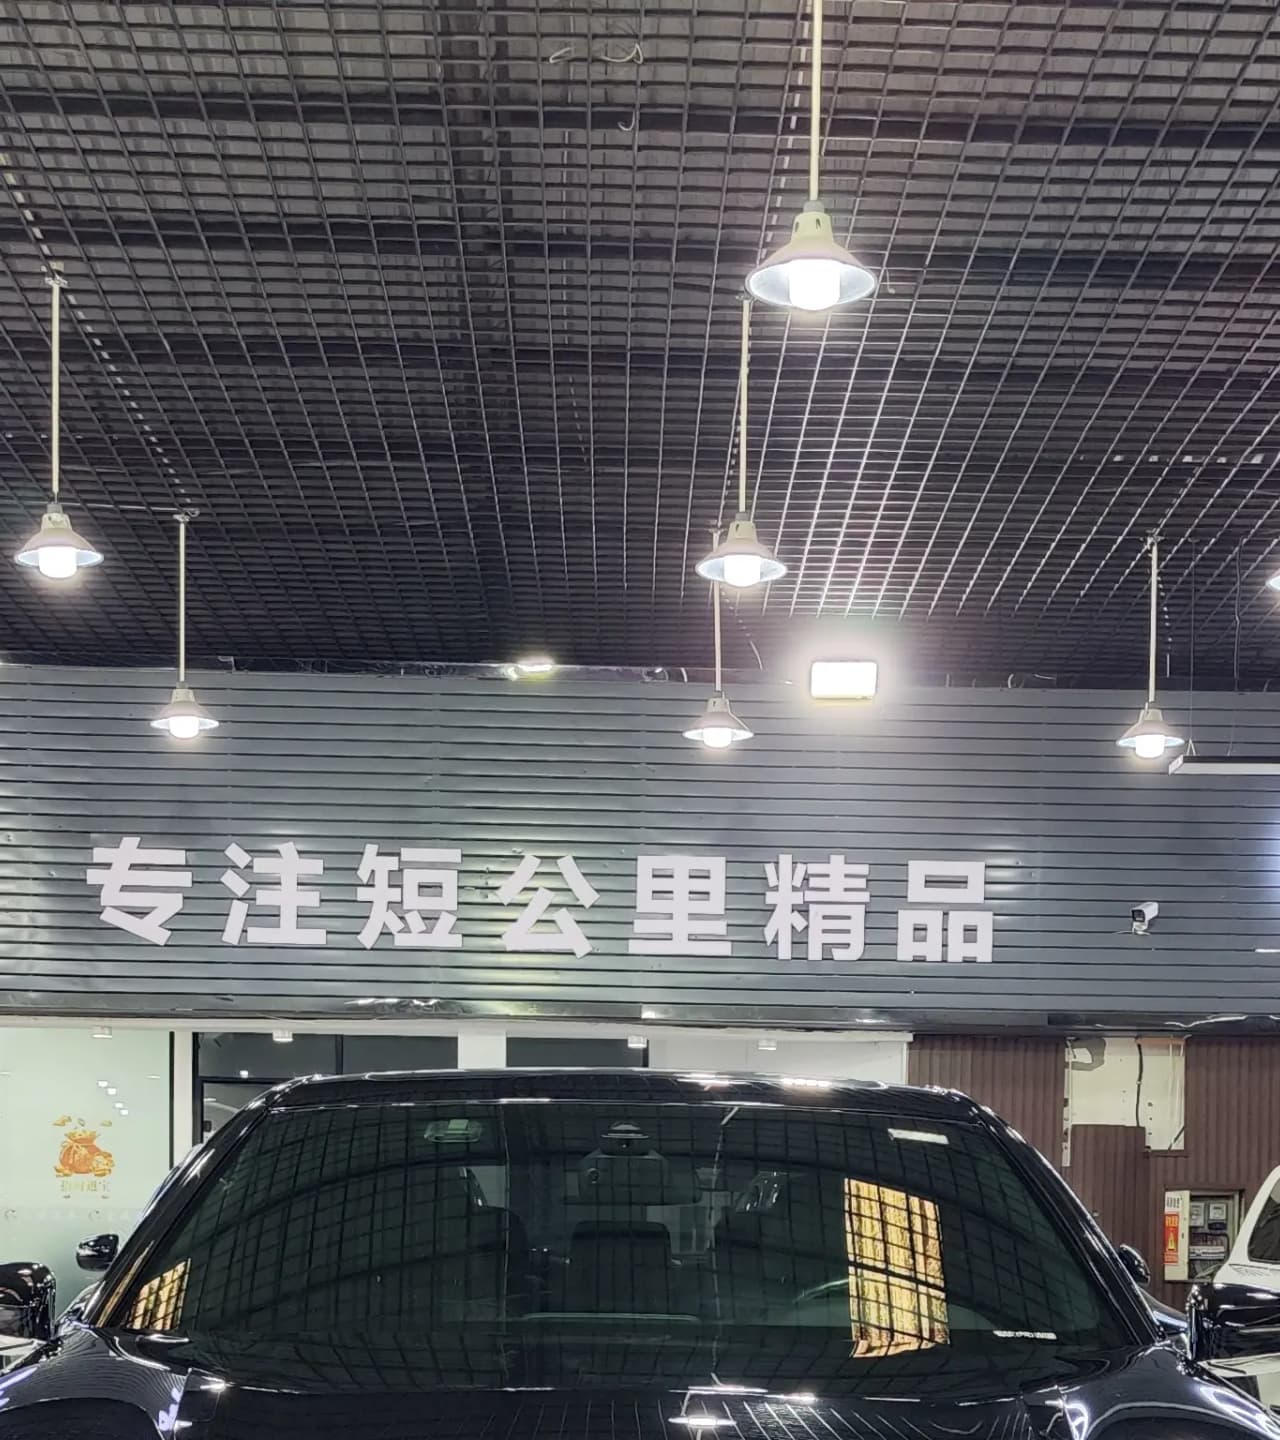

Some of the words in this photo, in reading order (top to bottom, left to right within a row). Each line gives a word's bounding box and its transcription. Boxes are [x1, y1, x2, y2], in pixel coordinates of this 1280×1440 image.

[86, 836, 994, 963] 专注短公里精品
